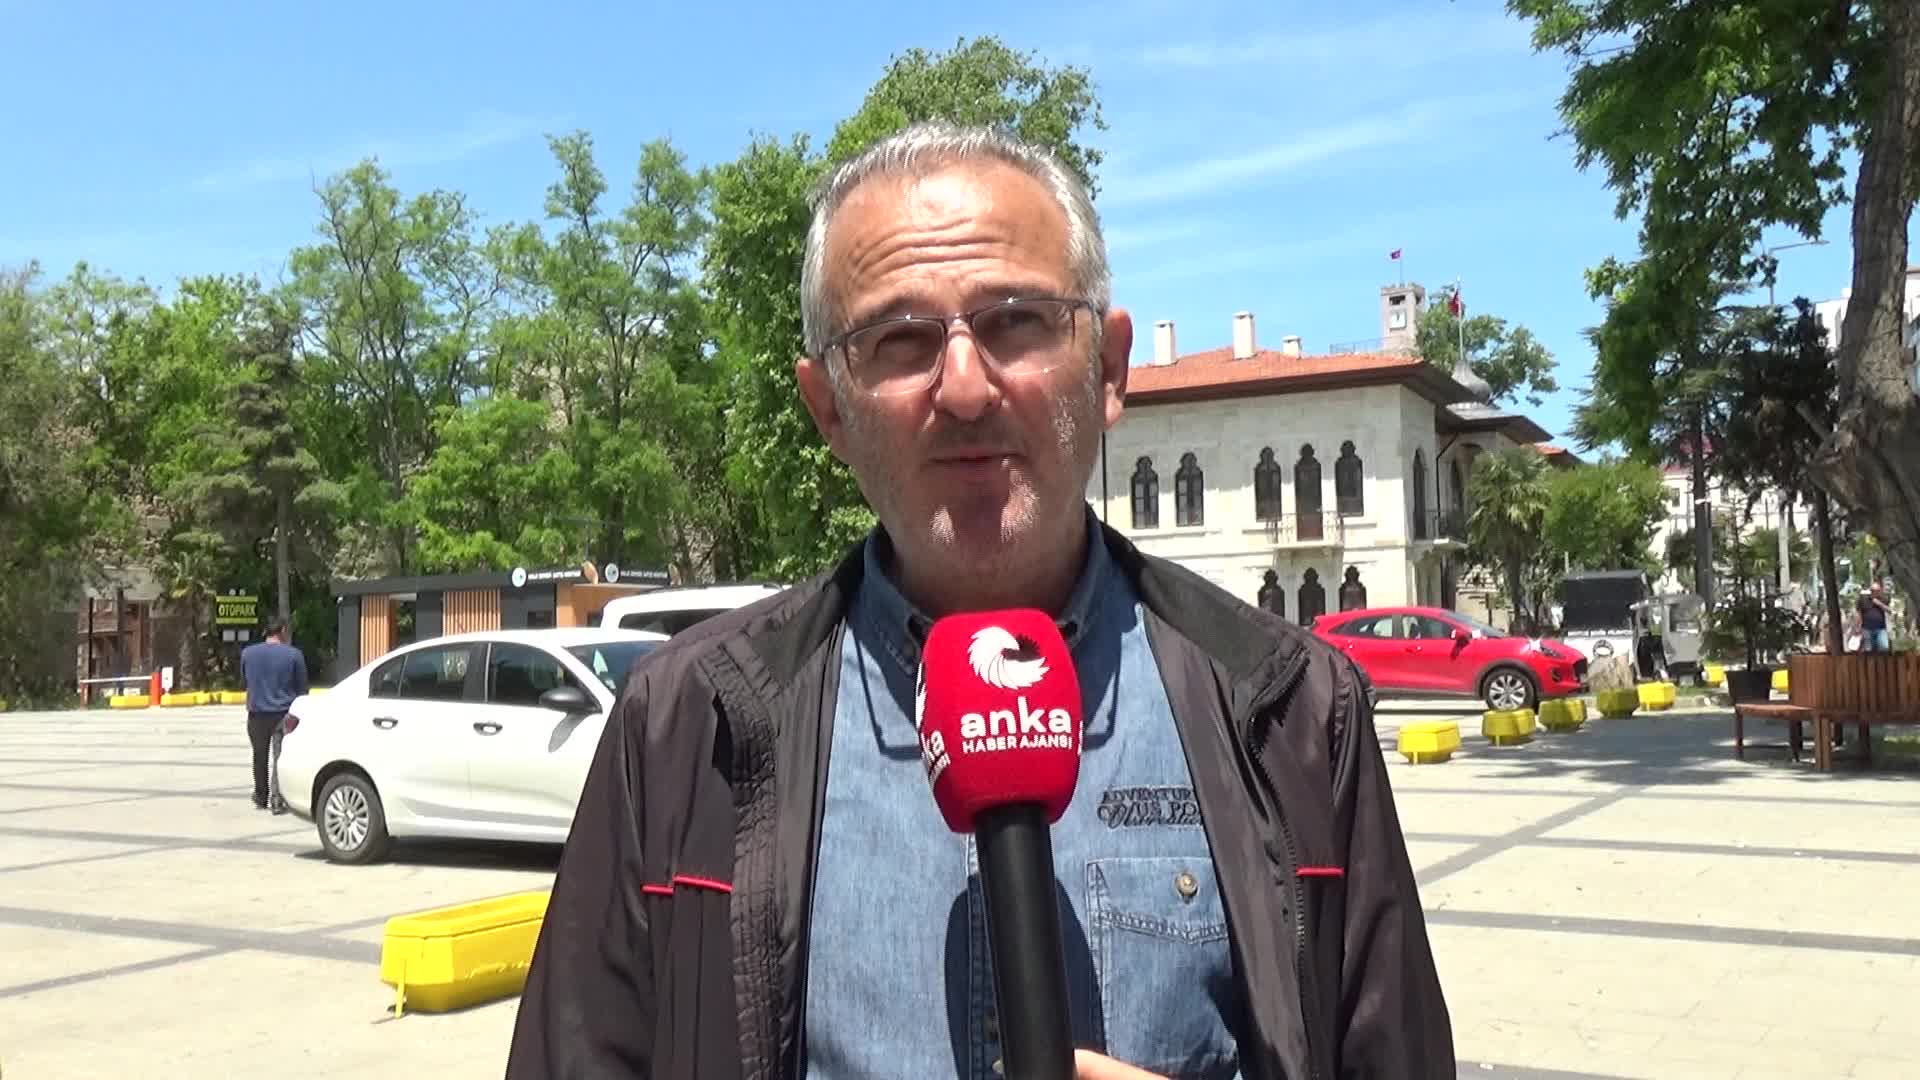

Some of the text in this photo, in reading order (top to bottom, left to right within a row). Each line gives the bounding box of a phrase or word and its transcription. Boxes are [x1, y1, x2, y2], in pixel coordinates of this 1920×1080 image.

[218, 604, 257, 617] OTOPARK
[960, 695, 1072, 739] anka
[962, 734, 1073, 754] HABER AJANSI
